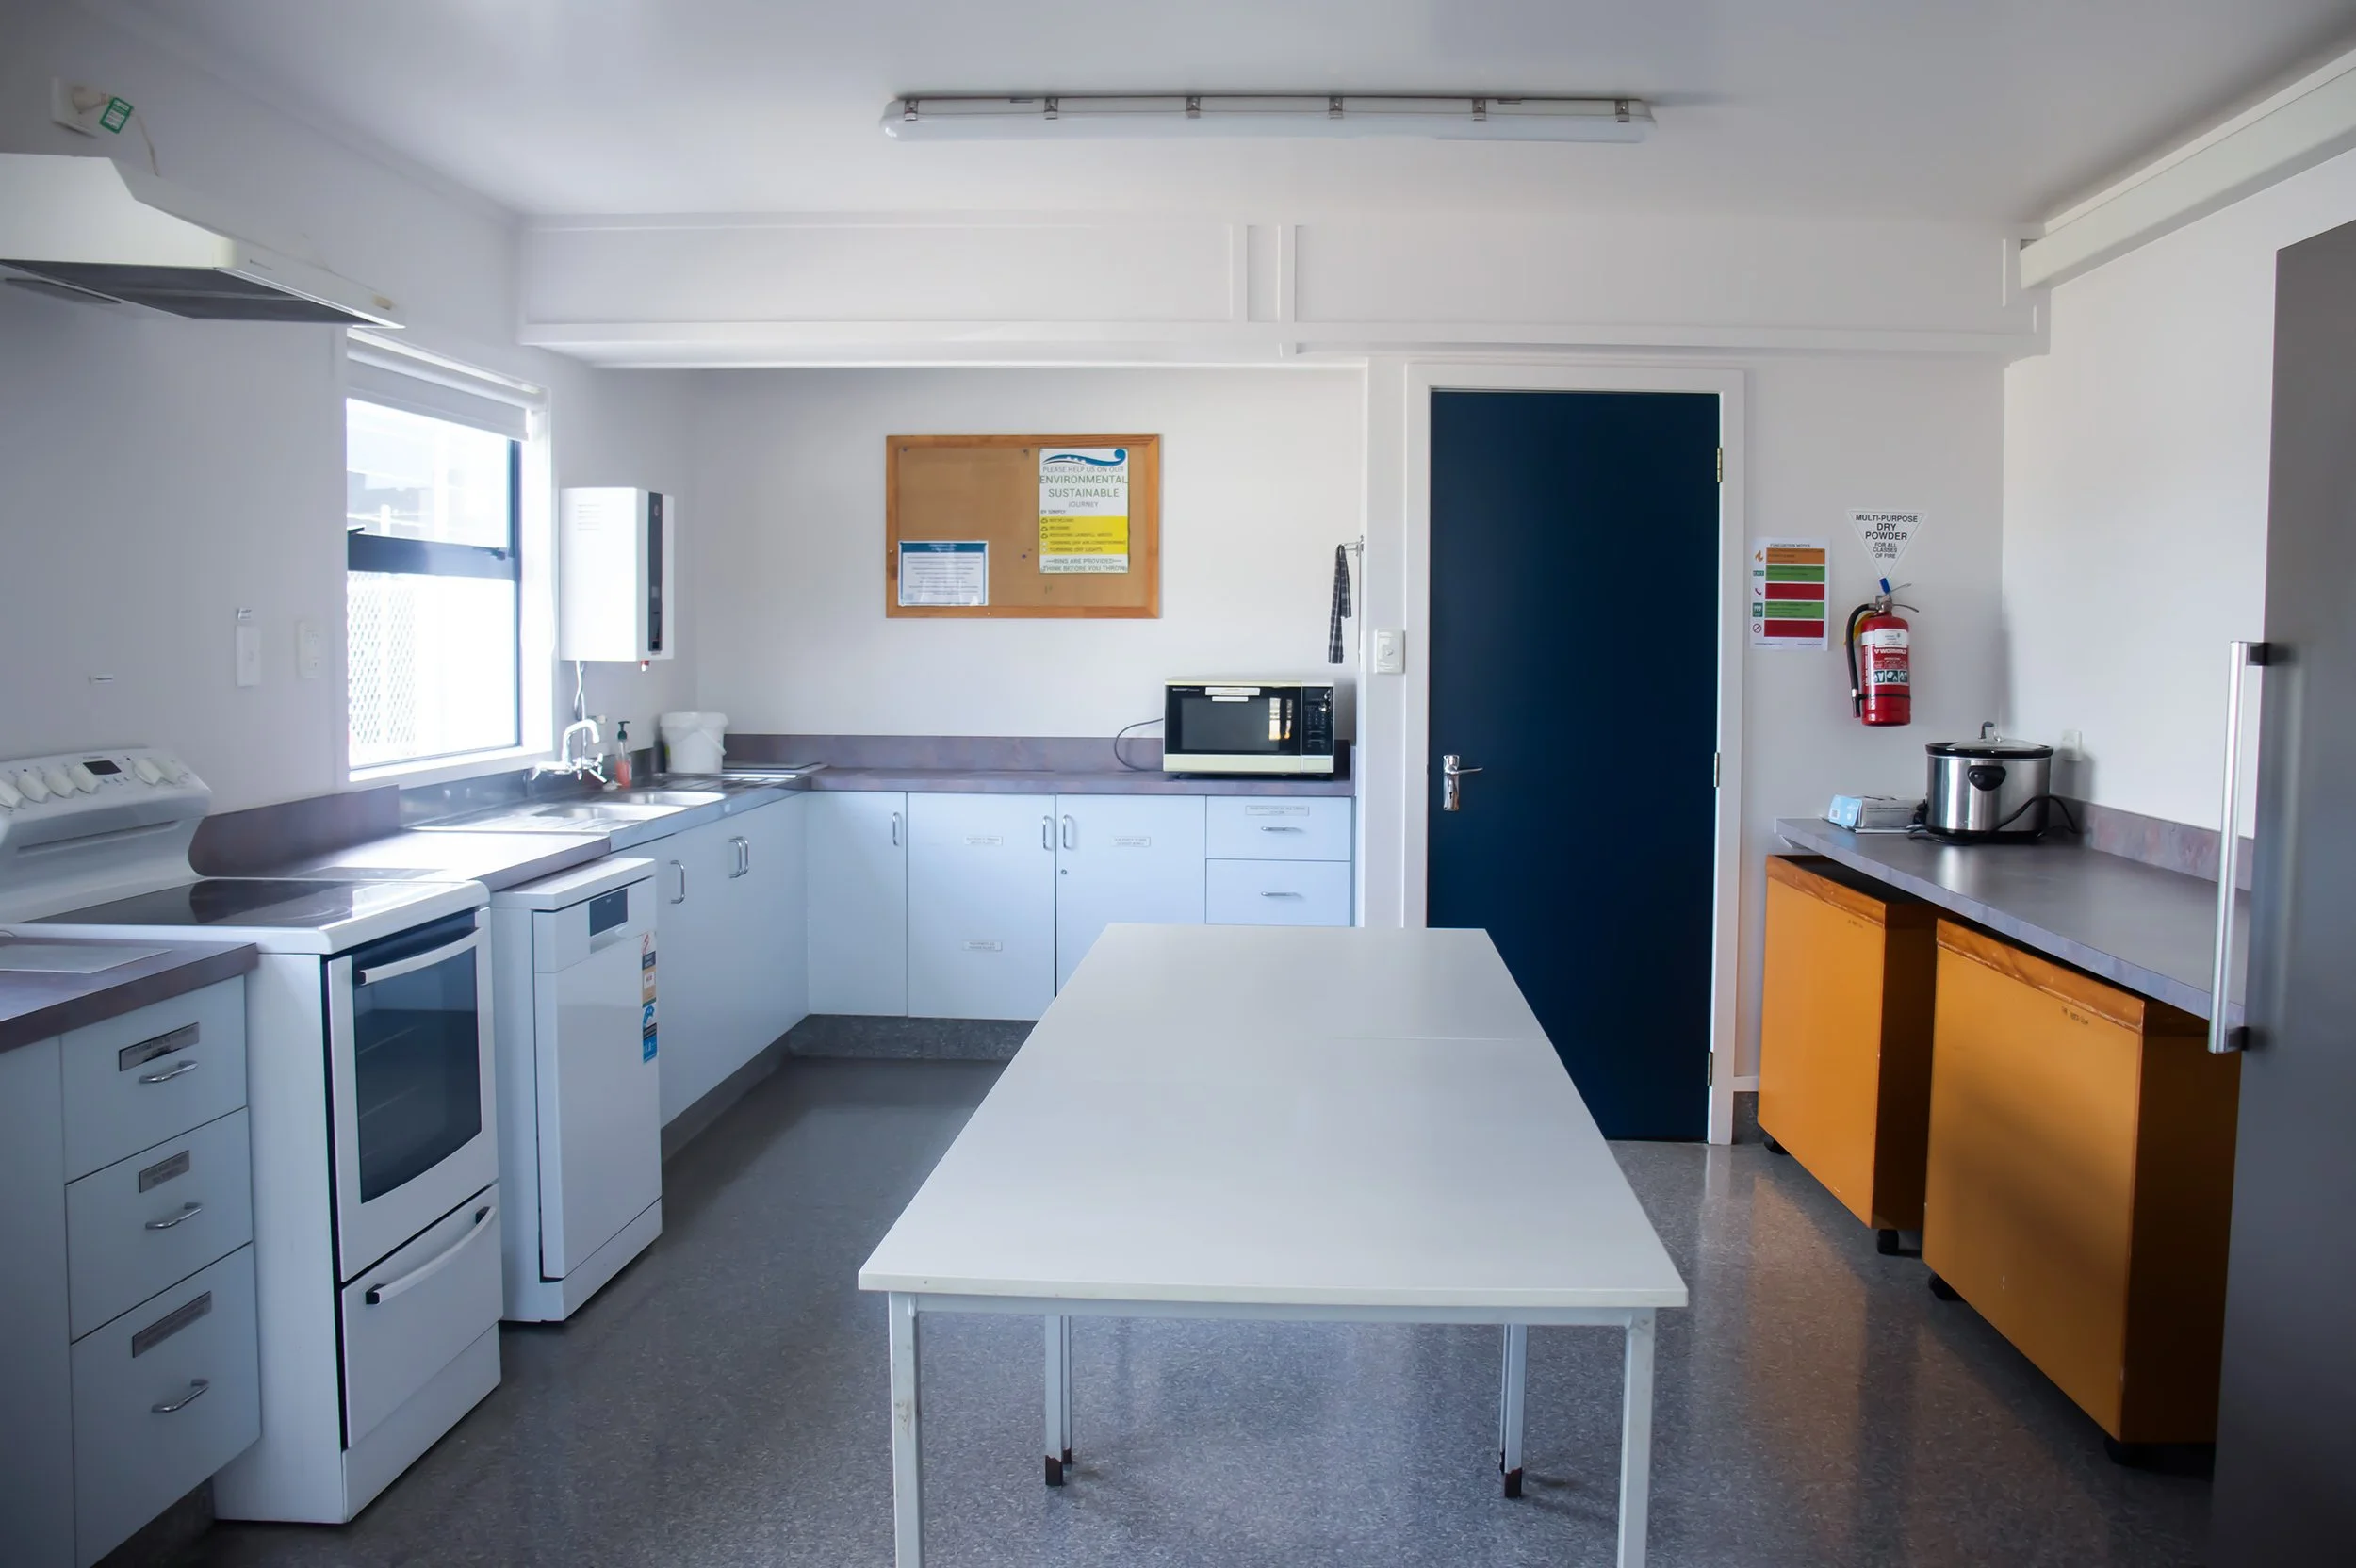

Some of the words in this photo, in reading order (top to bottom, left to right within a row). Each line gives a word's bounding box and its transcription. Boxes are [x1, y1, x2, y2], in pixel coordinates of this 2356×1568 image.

[1039, 475, 1128, 484] ENVIRONMENTAL
[1048, 488, 1120, 498] SUSTAINABLE
[1856, 514, 1918, 522] MULTI-PURPOSE
[1876, 522, 1896, 531] DRY
[1865, 531, 1907, 540] POWDER
